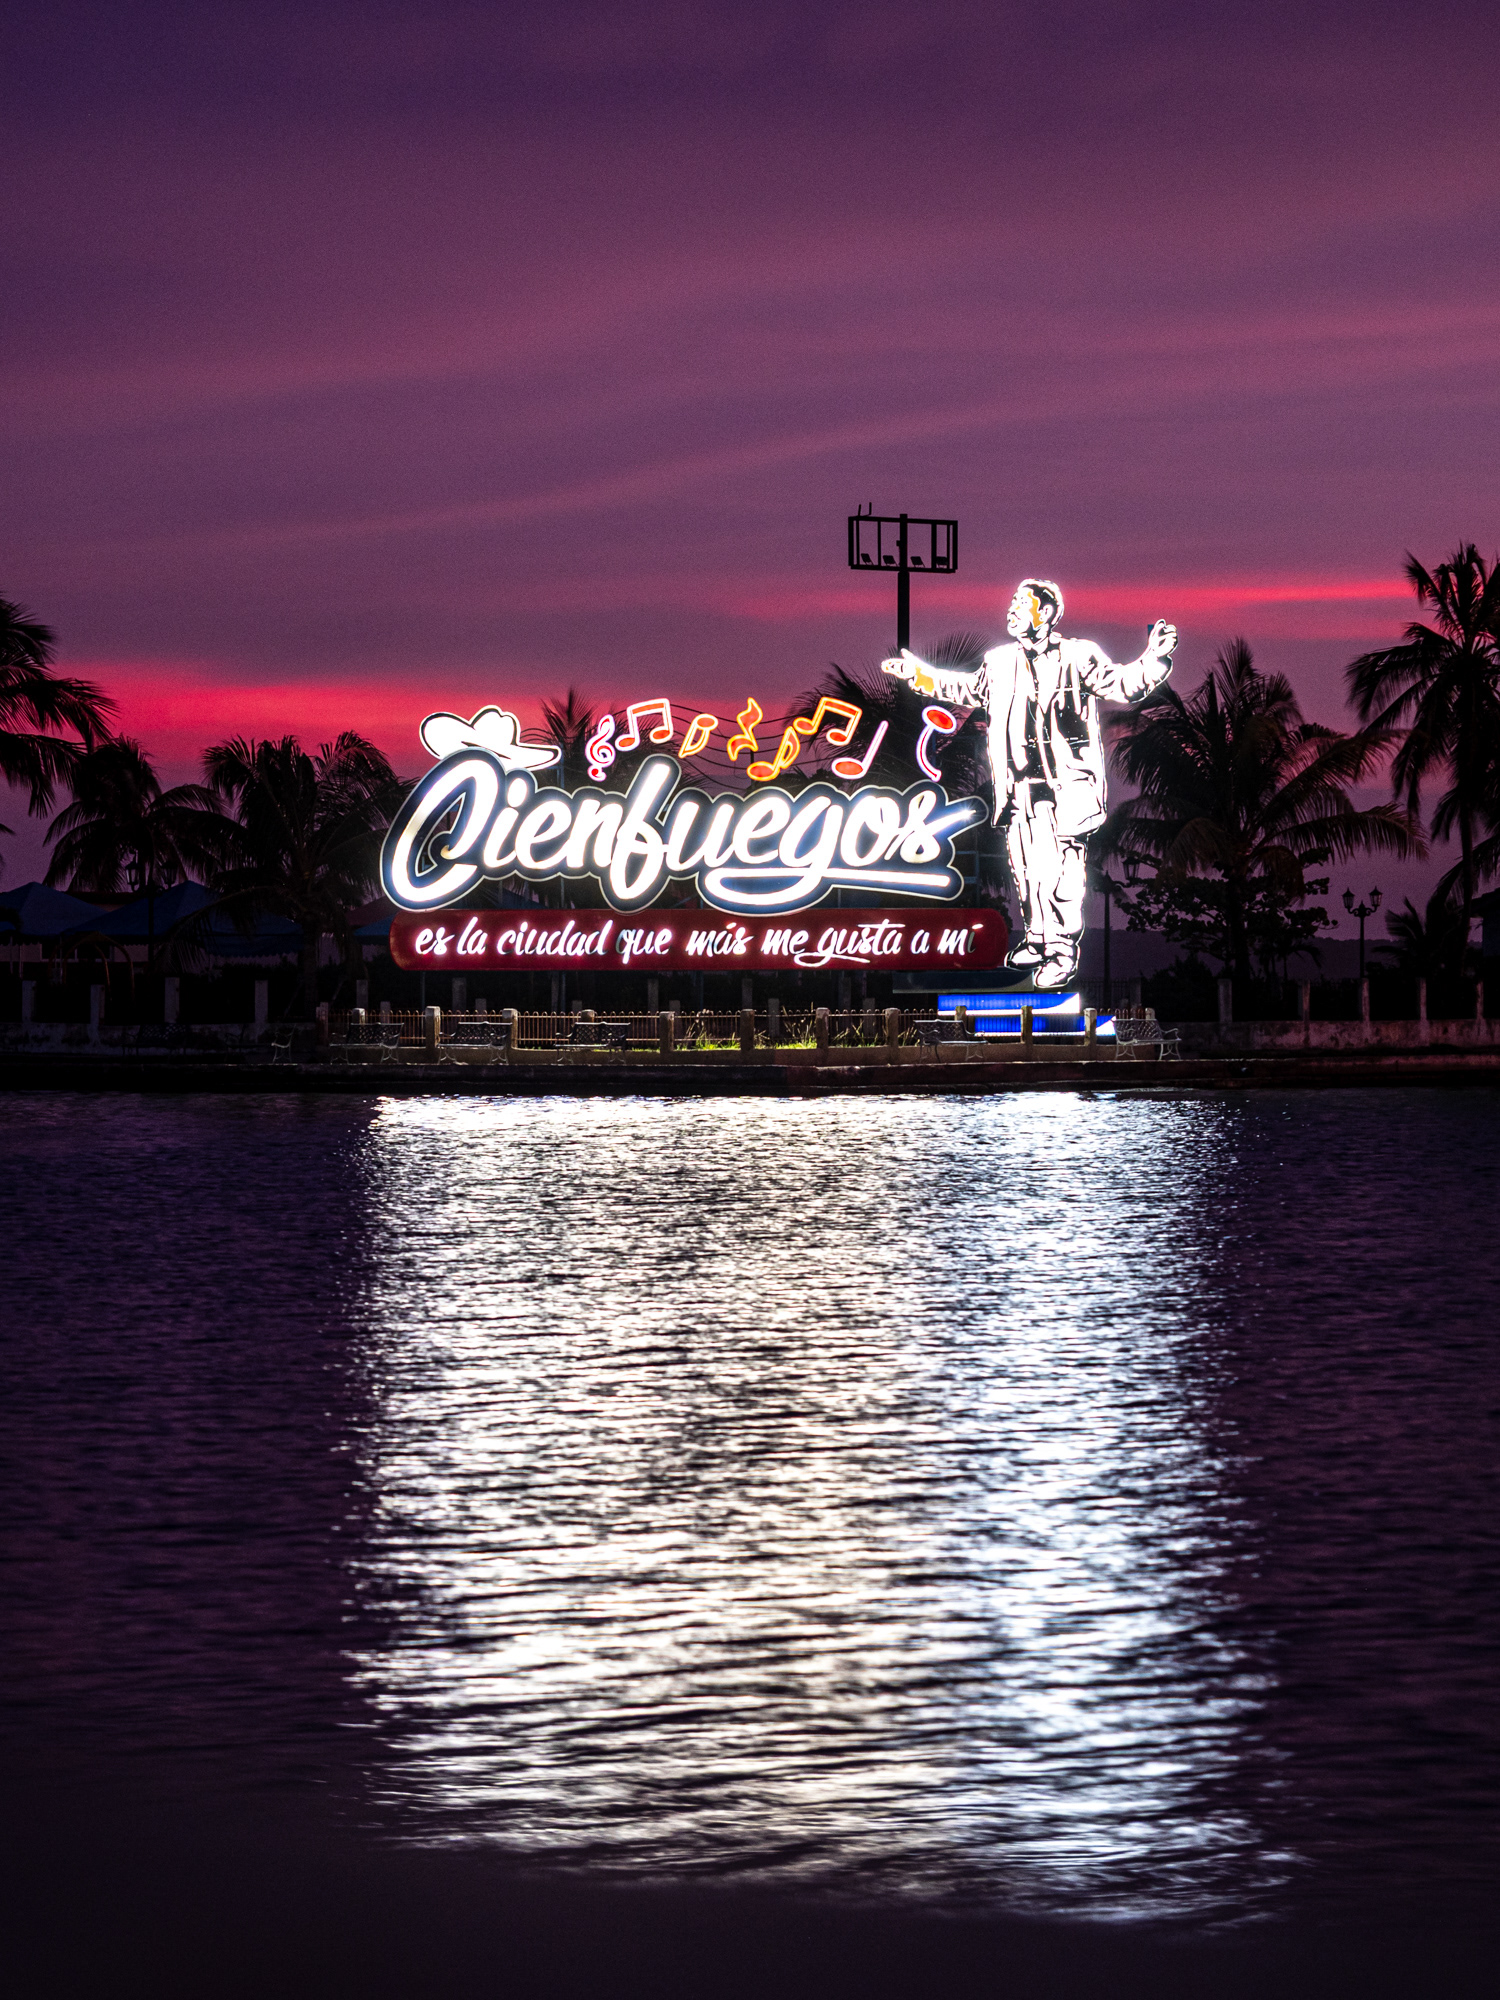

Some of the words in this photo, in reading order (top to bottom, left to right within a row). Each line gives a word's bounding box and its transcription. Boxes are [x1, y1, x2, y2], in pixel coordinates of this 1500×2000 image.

[390, 757, 978, 900] Cienfuegos
[414, 926, 454, 956] es
[456, 916, 488, 955] la
[496, 919, 614, 956] ciudad
[616, 927, 673, 965] que
[685, 922, 753, 957] más
[760, 928, 807, 956] me
[793, 918, 906, 967] gusta
[910, 930, 929, 955] a
